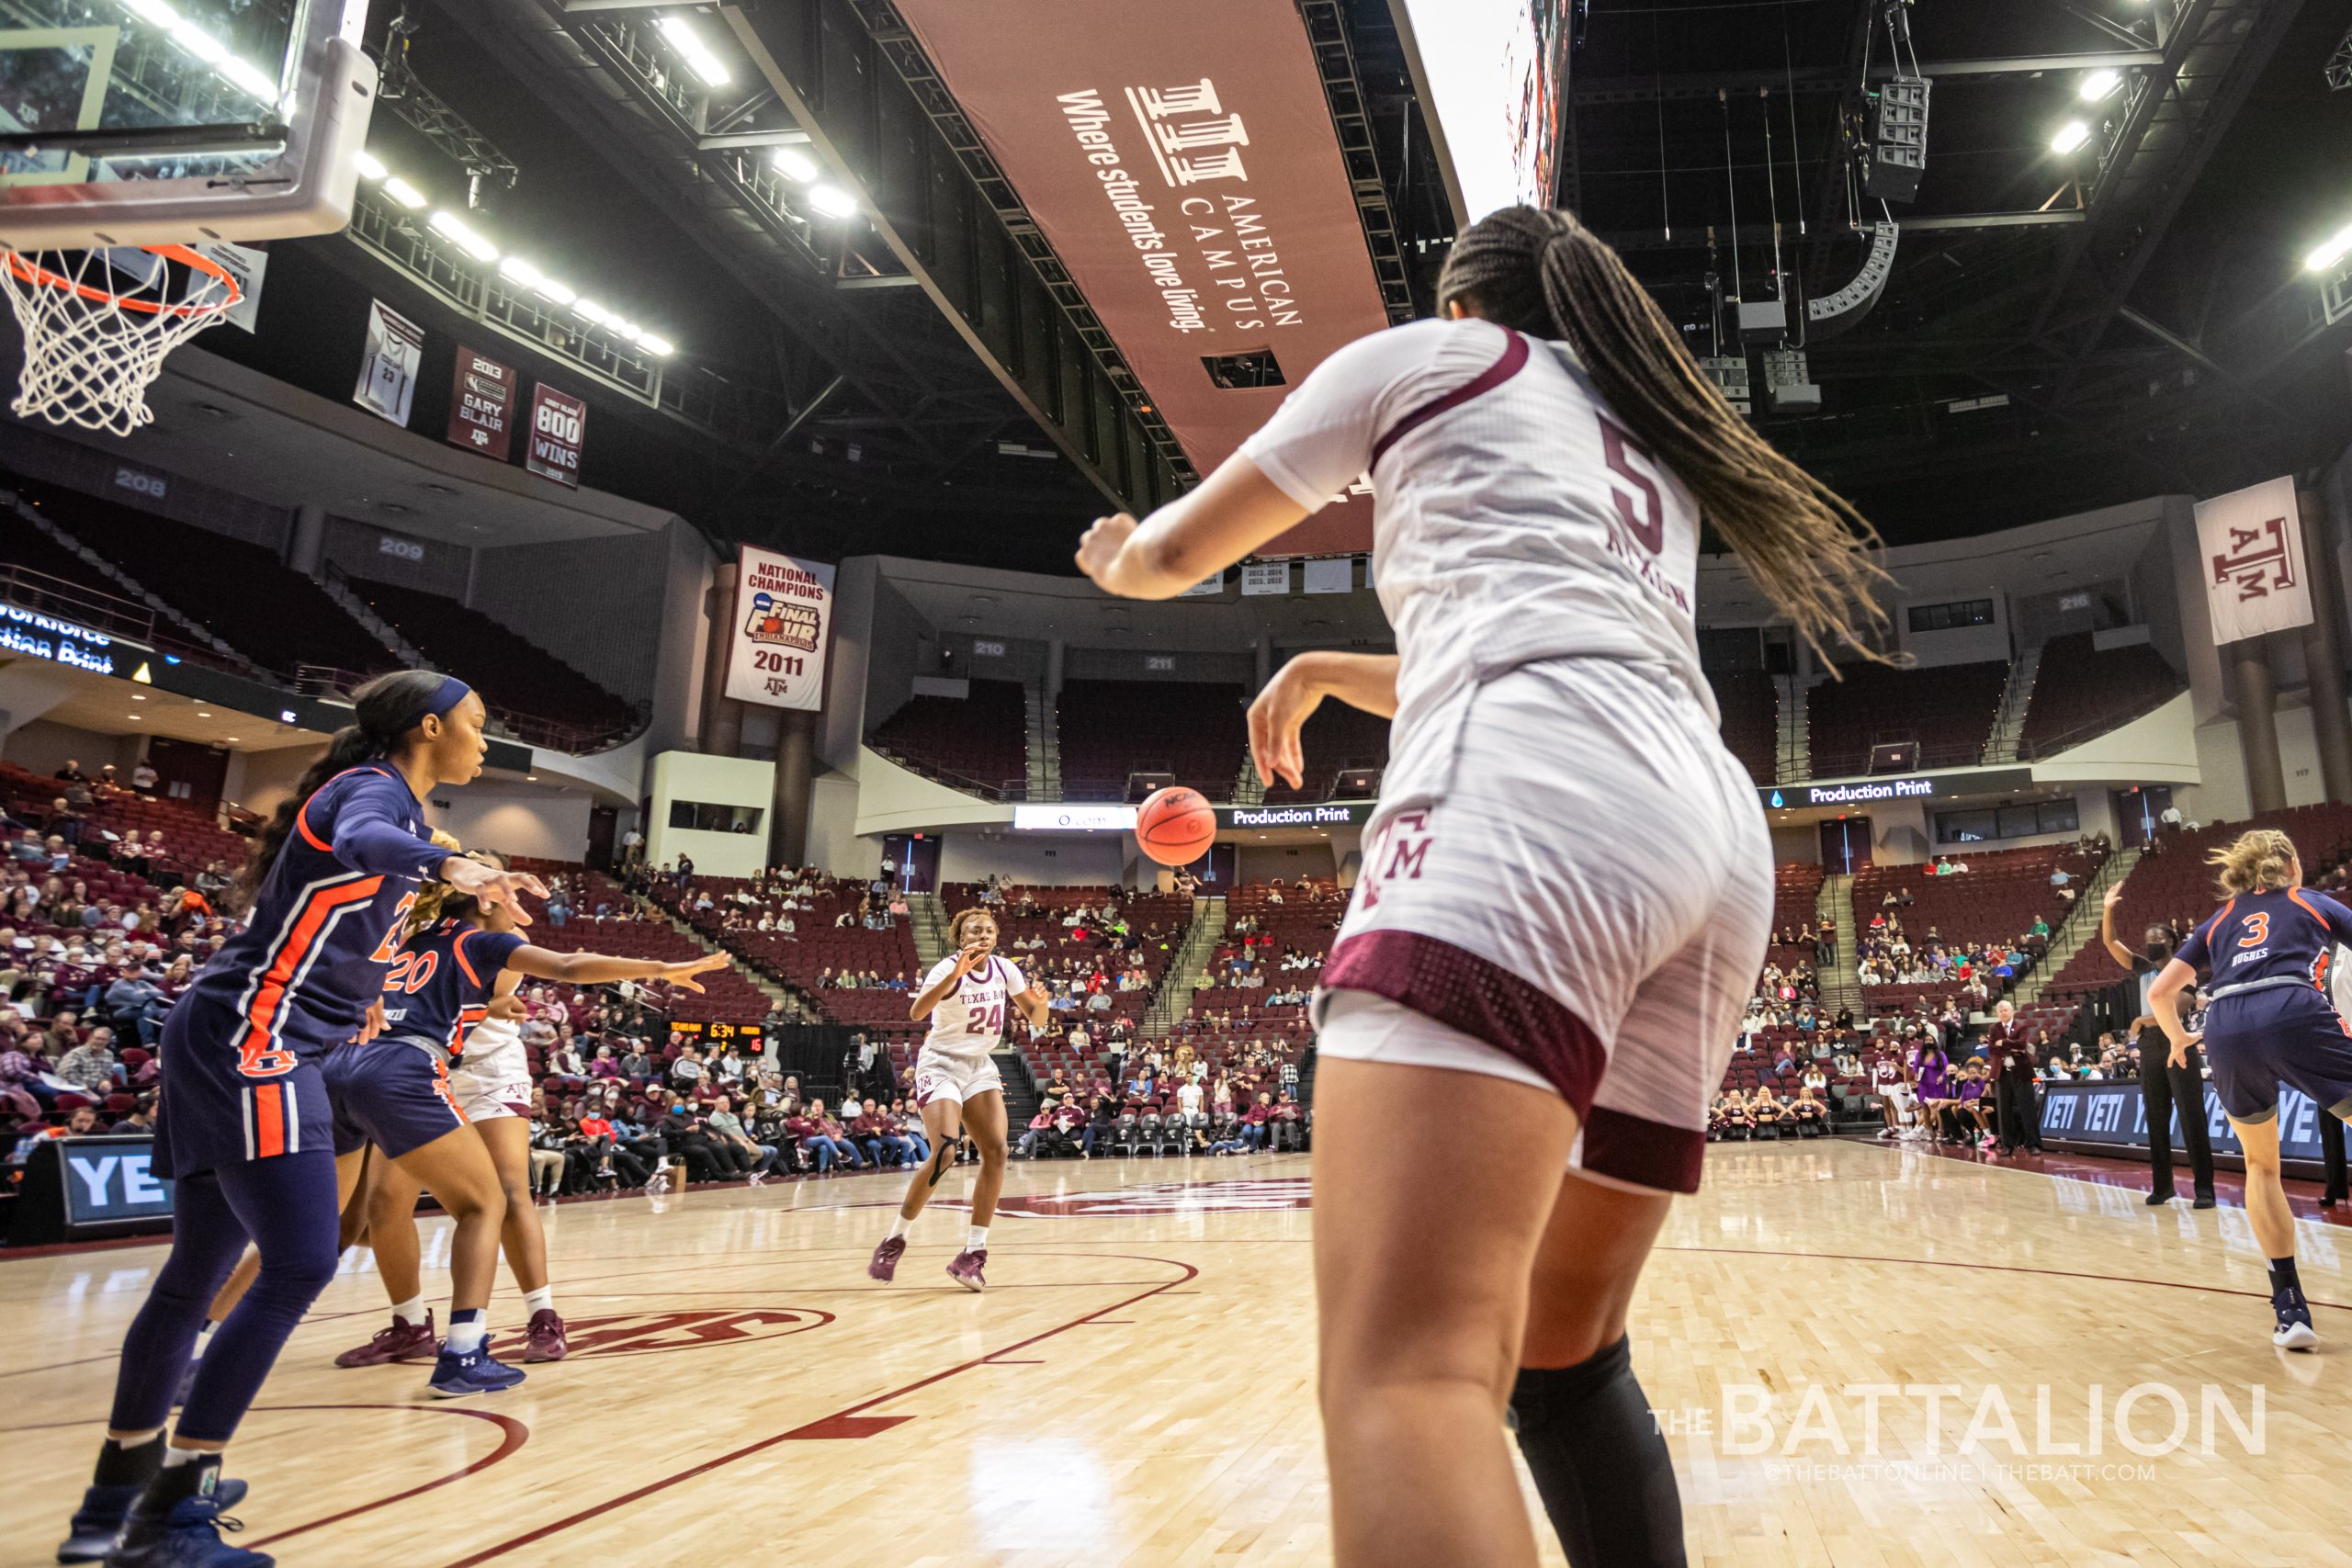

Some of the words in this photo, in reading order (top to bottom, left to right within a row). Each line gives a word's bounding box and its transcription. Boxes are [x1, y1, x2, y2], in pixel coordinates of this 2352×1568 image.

[1057, 89, 1121, 165] Where
[1097, 169, 1164, 251] students
[1142, 253, 1183, 288] love
[1181, 197, 1265, 330] CAMPUS
[1222, 194, 1303, 327] AMERICAN
[472, 358, 503, 379] 2013
[459, 405, 503, 432] BLAIR
[464, 393, 503, 417] GARY
[537, 405, 581, 444] 800
[535, 437, 579, 469] WINS
[116, 470, 165, 497] 208
[1595, 411, 1663, 555] 5
[380, 537, 423, 559] 209
[749, 574, 823, 601] CHAMPIONS
[758, 562, 817, 586] NATIONAL
[769, 602, 817, 626] FINAL
[755, 632, 813, 649] INDIANAPOLIS
[975, 643, 1004, 656] 210
[754, 649, 803, 676] 2011
[1148, 658, 1173, 670] 211
[1811, 784, 1893, 804] Production
[1895, 781, 1932, 796] Print
[1234, 808, 1312, 825] Production
[1316, 807, 1350, 822] Print
[2237, 911, 2270, 948] 3
[2232, 947, 2268, 967] HUGHES
[382, 950, 439, 995] 20
[960, 992, 991, 1004] TEXAS
[710, 1023, 734, 1038] 6:34
[966, 1004, 1002, 1035] 24
[2043, 1094, 2077, 1130] YETI
[2084, 1094, 2125, 1133] YETI
